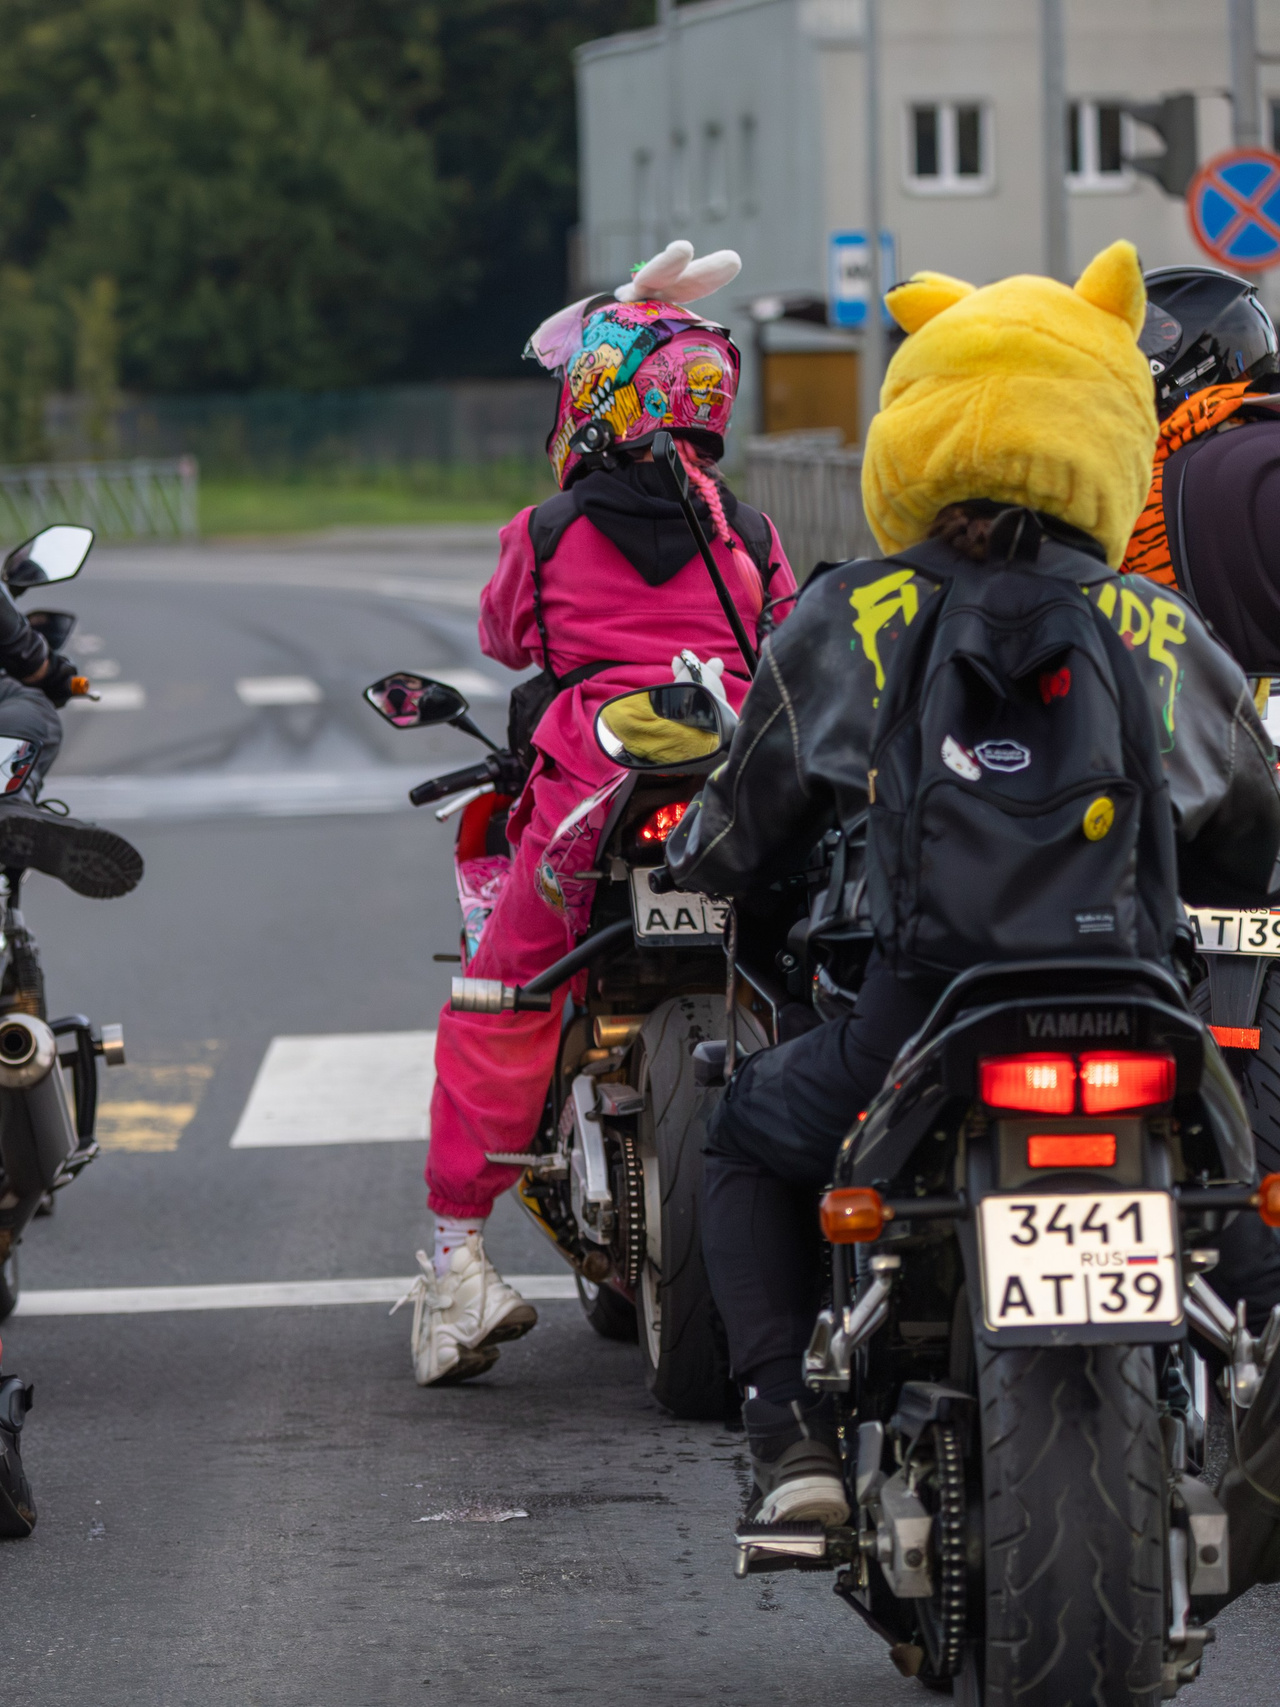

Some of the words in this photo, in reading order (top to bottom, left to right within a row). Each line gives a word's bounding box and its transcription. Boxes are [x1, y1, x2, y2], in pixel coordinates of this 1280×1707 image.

[645, 908, 698, 931] AA
[1026, 1012, 1130, 1037] YAMAHA
[1010, 1201, 1144, 1246] 3441
[1081, 1252, 1124, 1266] RUS
[999, 1274, 1074, 1318] AT
[1099, 1272, 1163, 1313] 39
